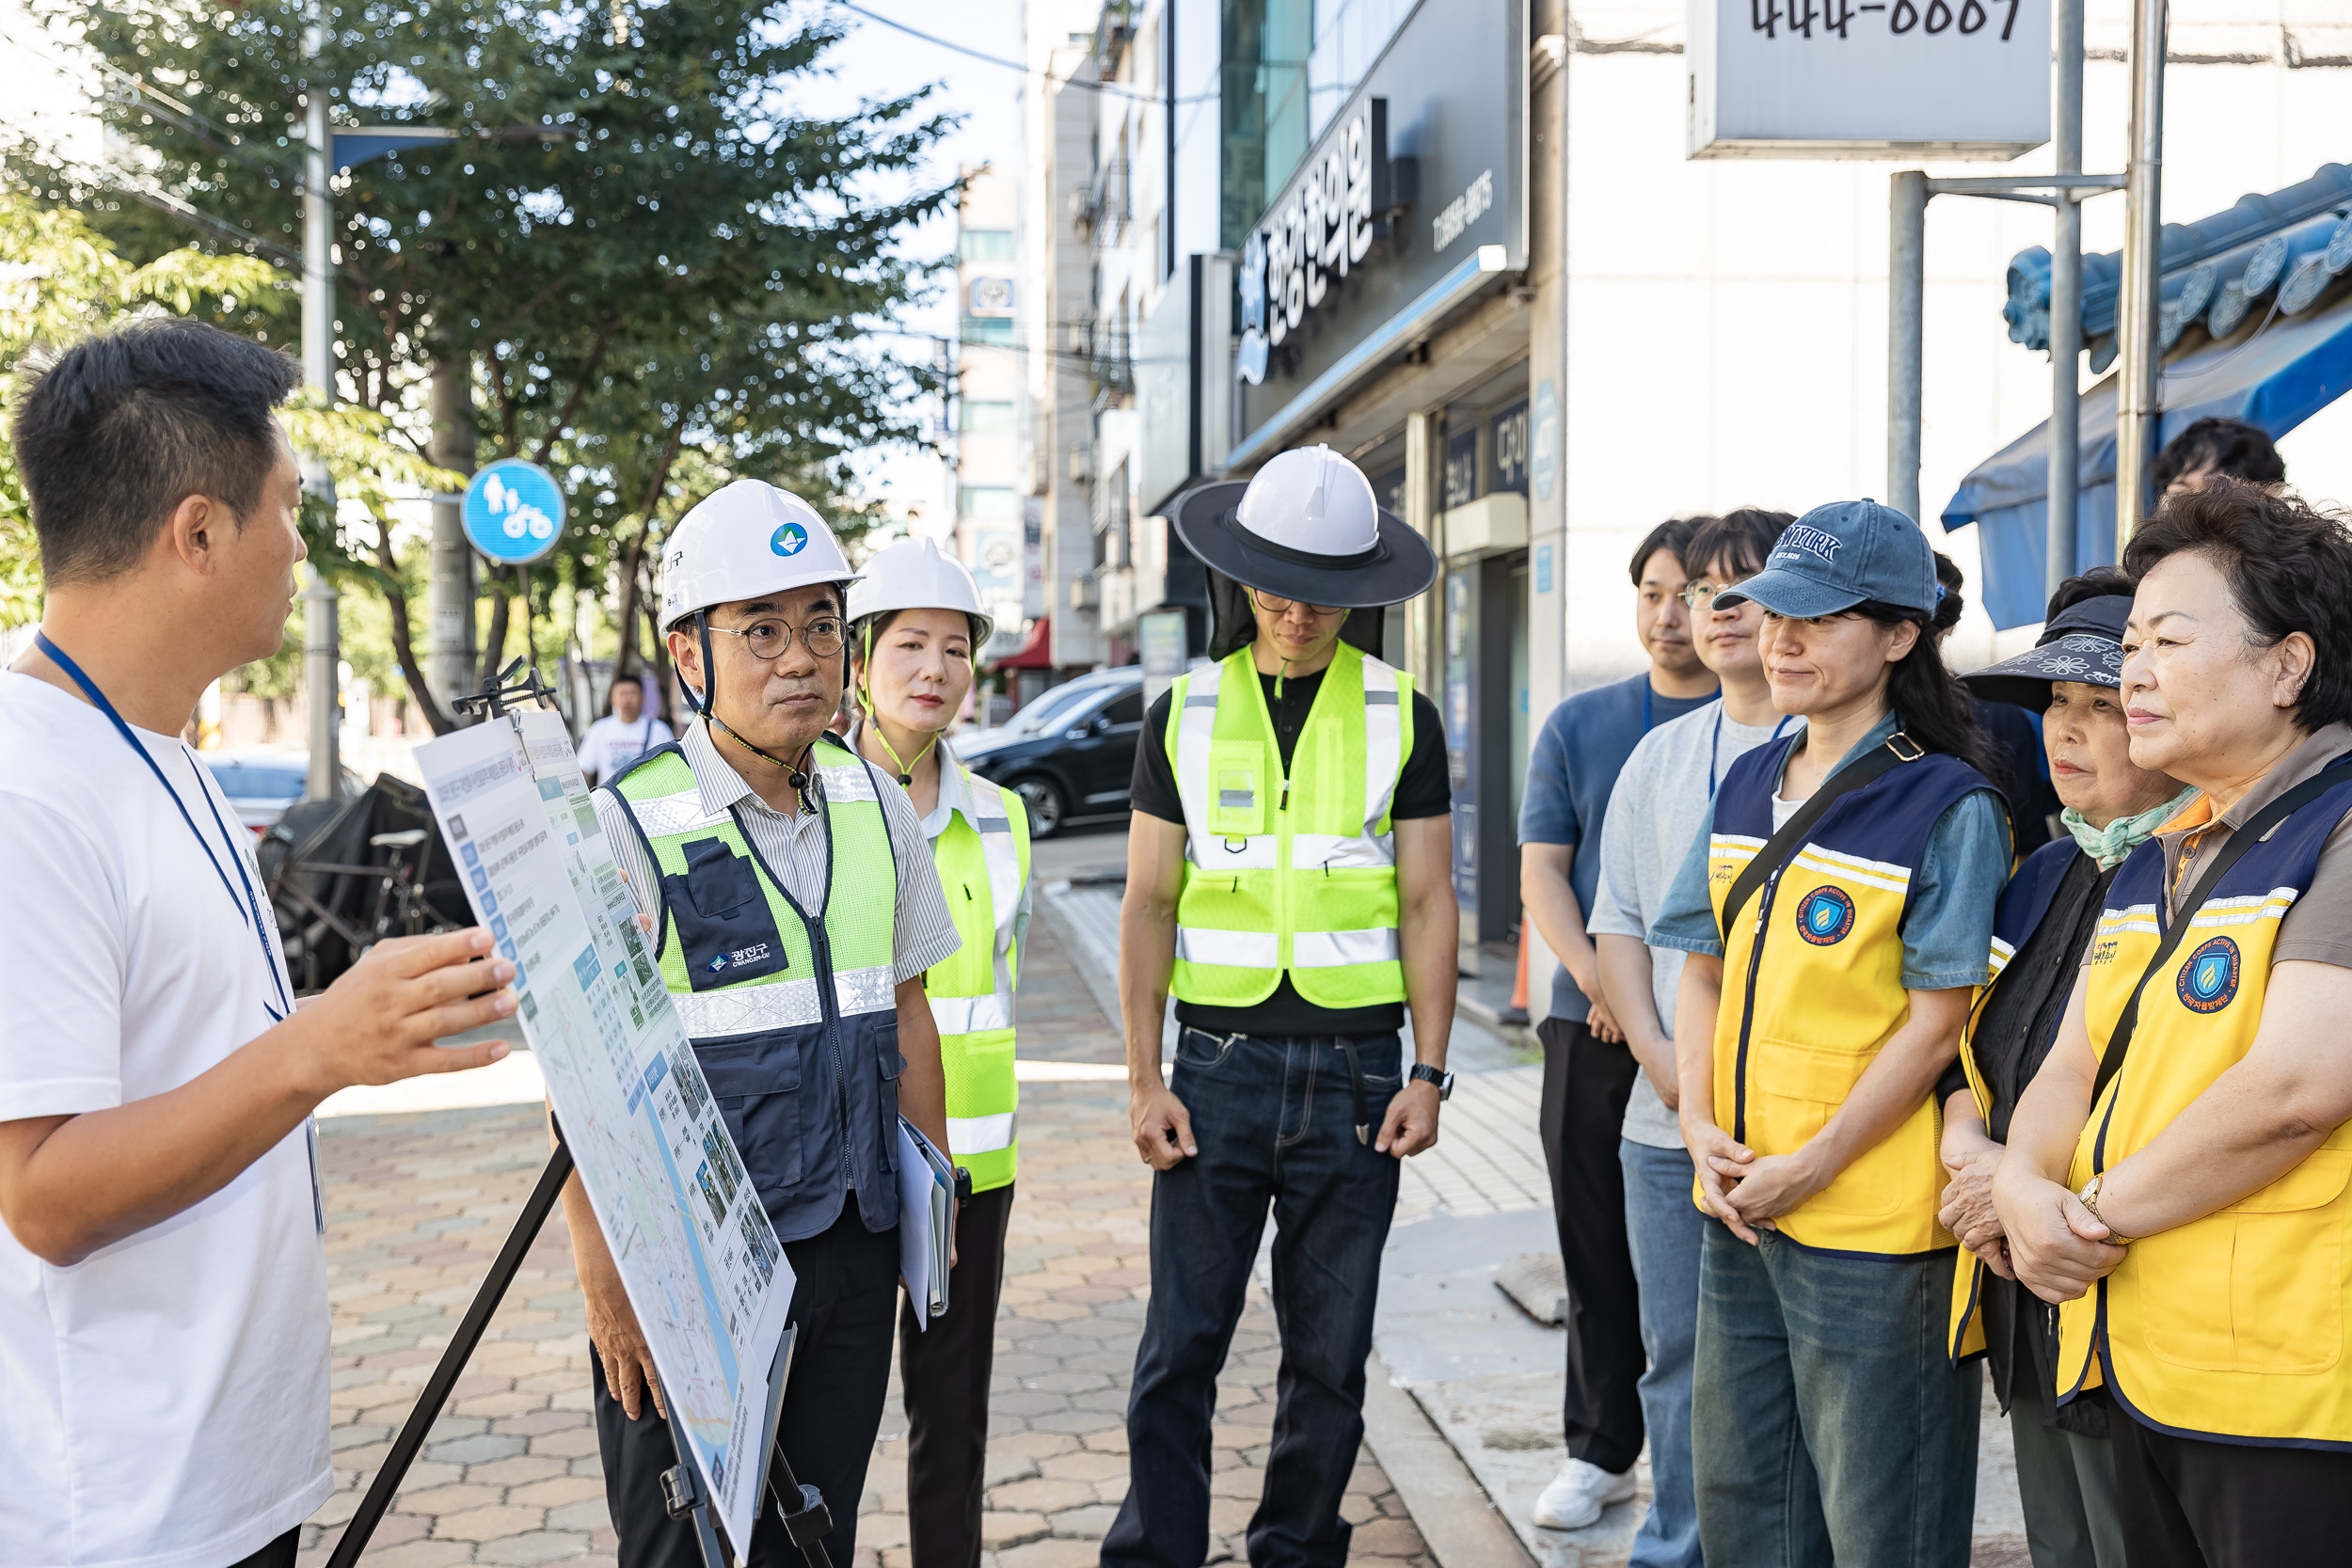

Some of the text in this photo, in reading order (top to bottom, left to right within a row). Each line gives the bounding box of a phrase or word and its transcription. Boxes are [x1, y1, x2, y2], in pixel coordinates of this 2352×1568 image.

[1792, 525, 1843, 563] YORK
[782, 764, 797, 774] SAFET
[731, 942, 769, 961] 광진구
[732, 952, 771, 968] GWANGJIN-GU
[2179, 939, 2238, 988] CITIZEN CORPS ACTIVE IN DISASTER
[2183, 992, 2229, 1011] 전국자율방재단
